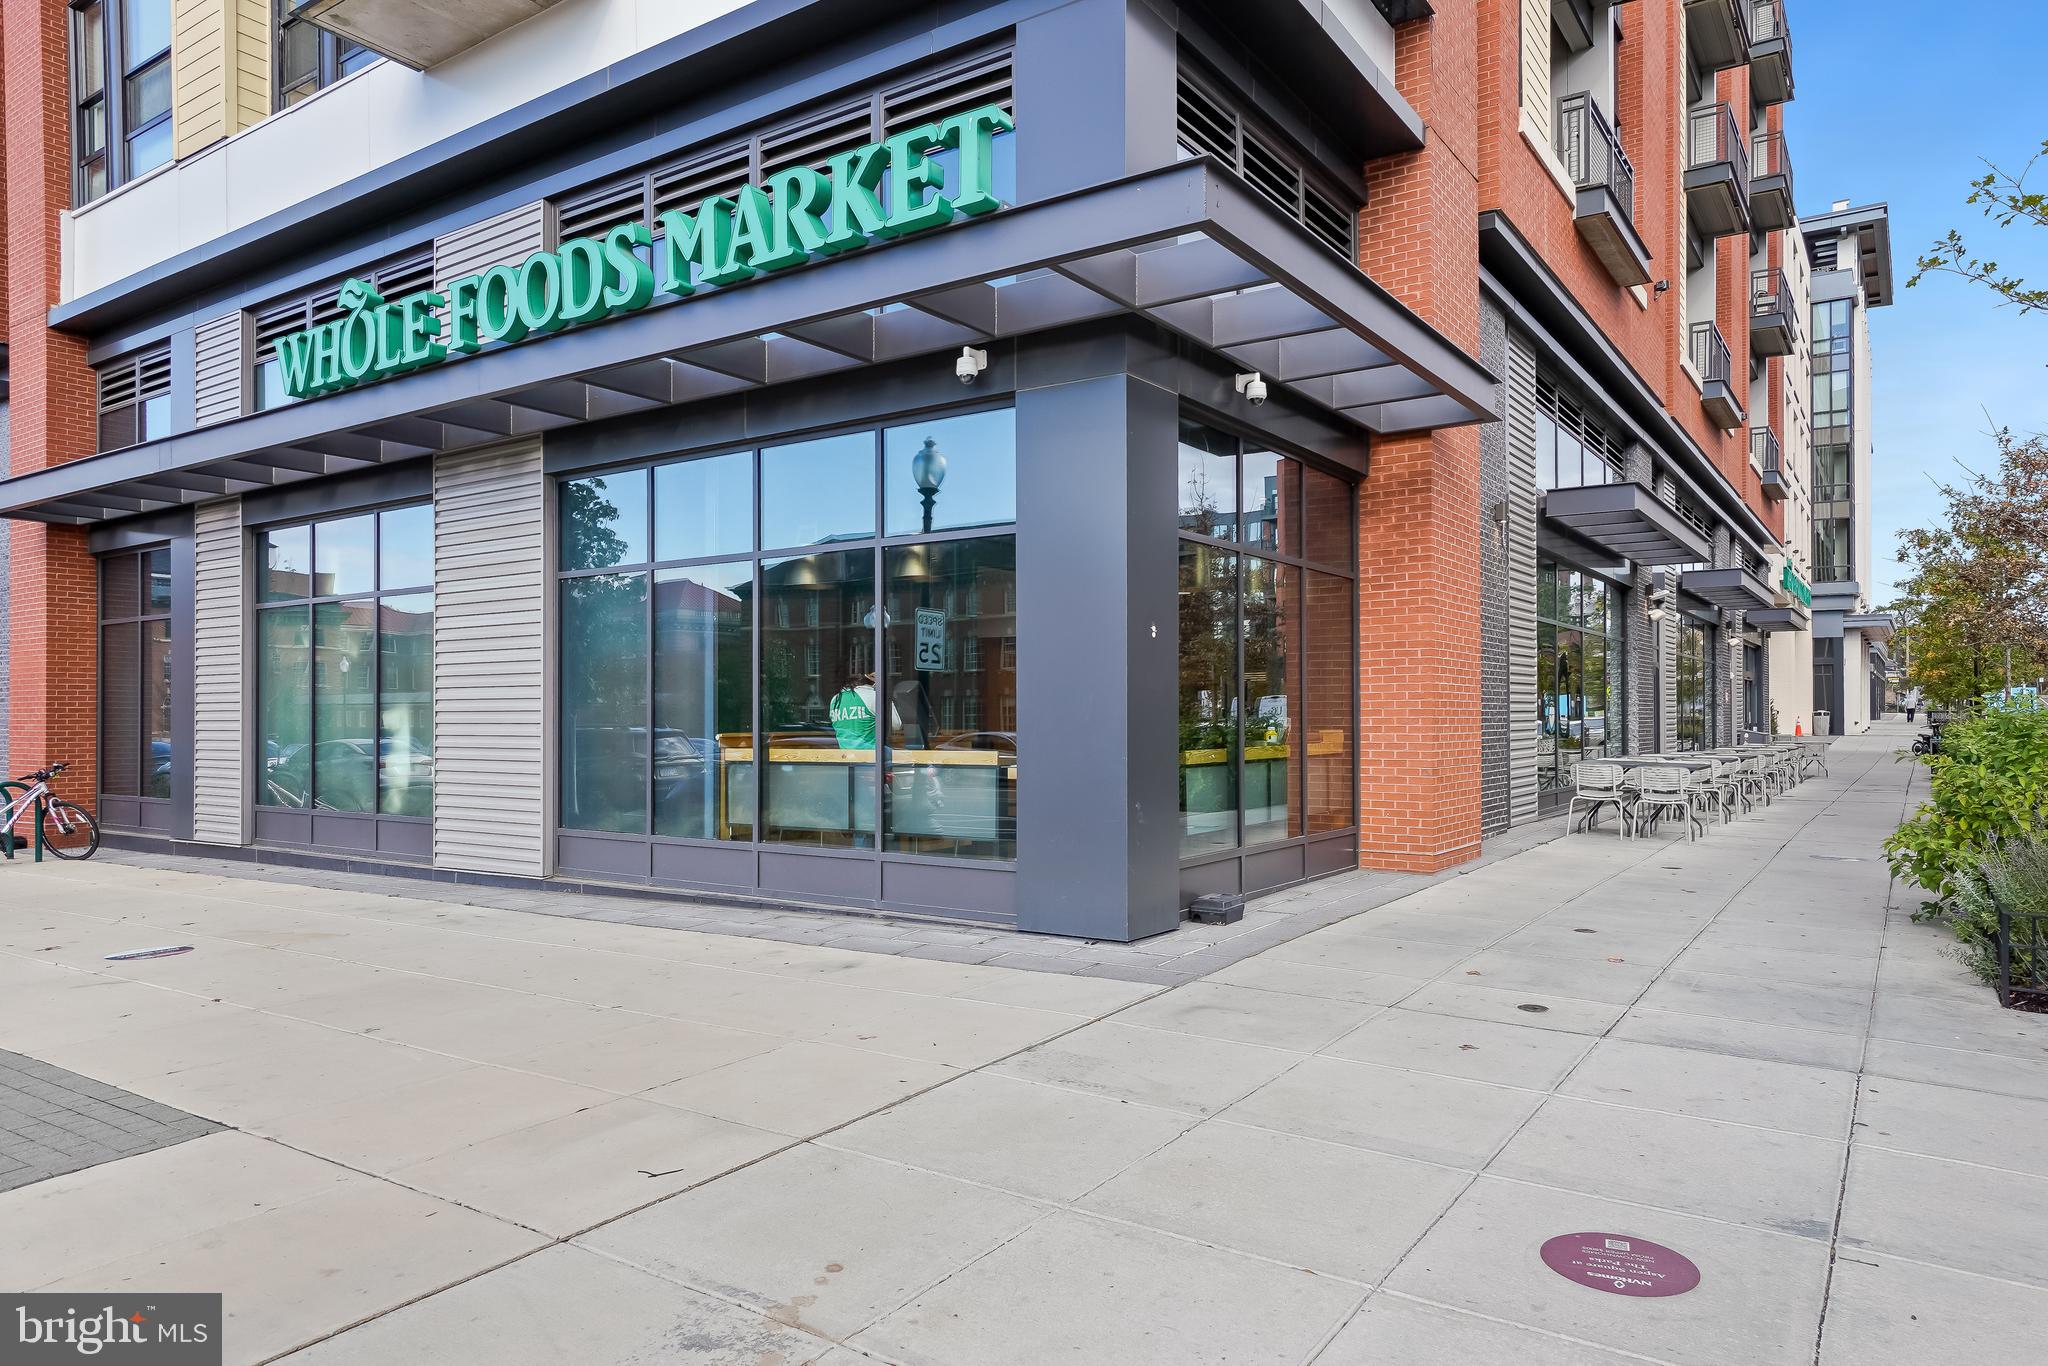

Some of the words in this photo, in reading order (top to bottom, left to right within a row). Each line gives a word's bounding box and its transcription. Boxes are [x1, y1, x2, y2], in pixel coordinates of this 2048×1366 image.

[447, 222, 652, 355] FOODS
[661, 104, 1014, 296] MARKET
[830, 706, 870, 722] BRAZIL
[1588, 1257, 1621, 1266] Parks
[1624, 1262, 1648, 1270] The
[1586, 1262, 1626, 1273] Square
[1586, 1271, 1652, 1286] NVHomes
[1629, 1269, 1666, 1279] Aspen
